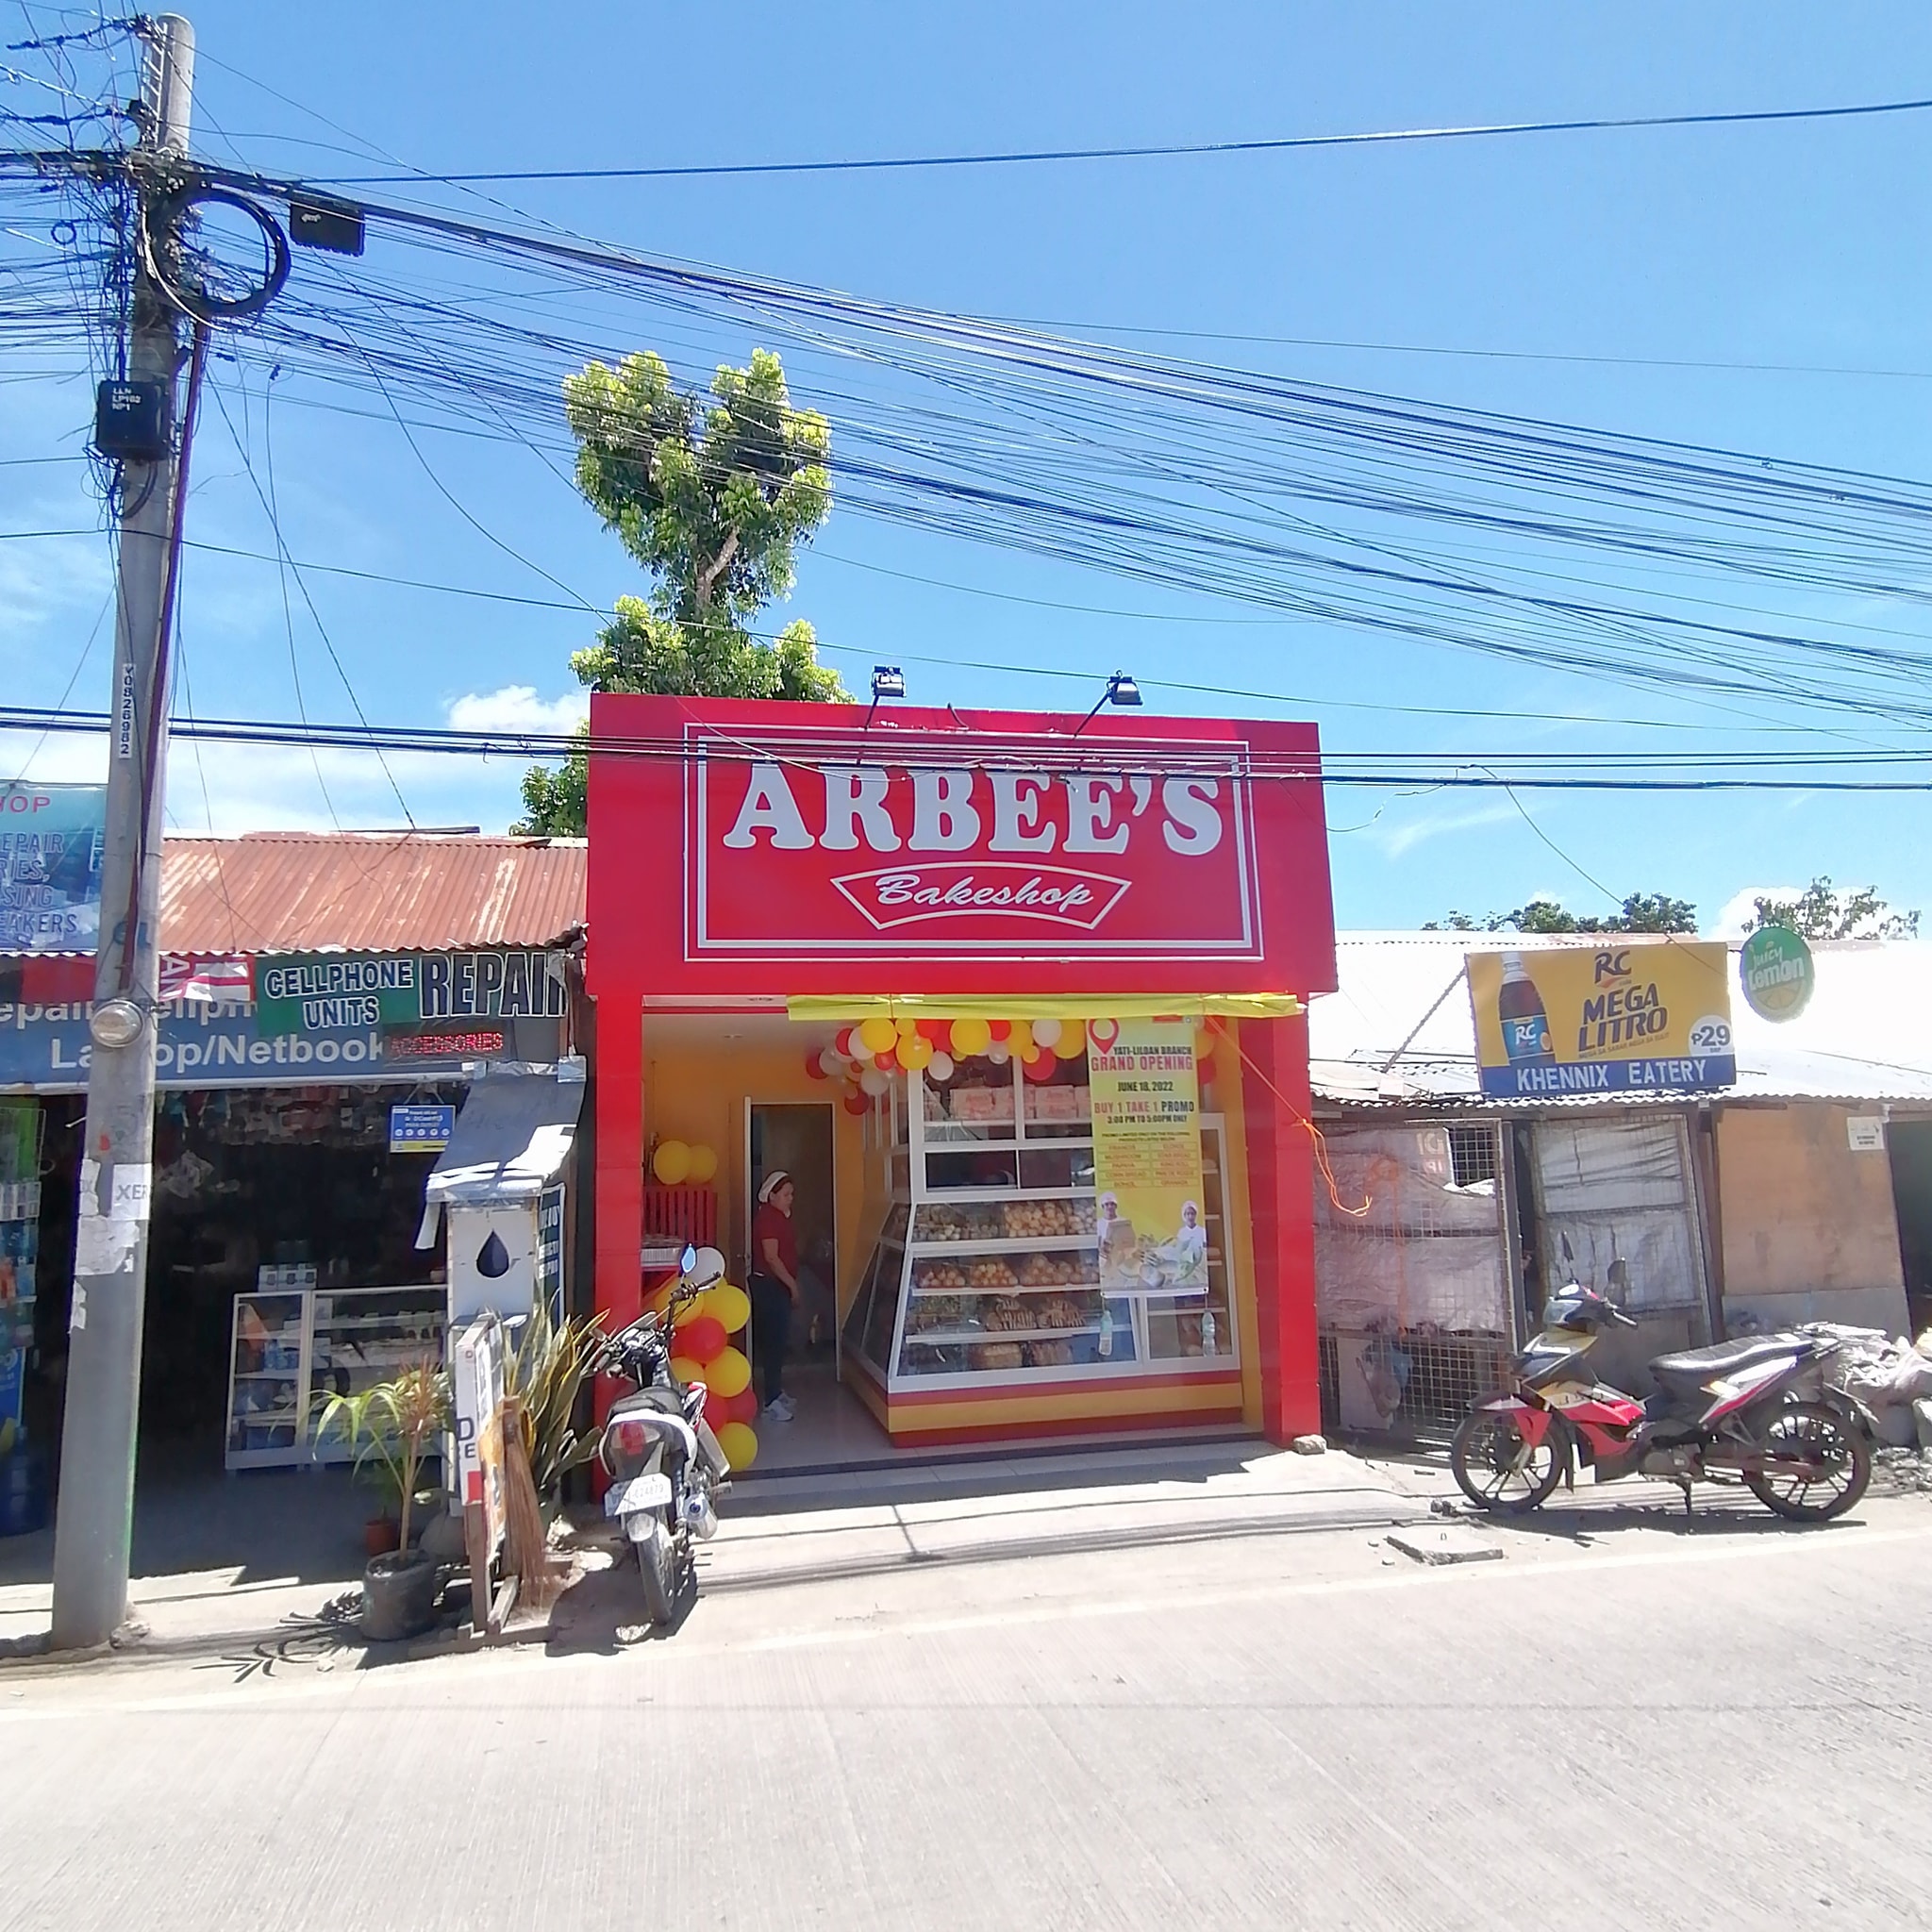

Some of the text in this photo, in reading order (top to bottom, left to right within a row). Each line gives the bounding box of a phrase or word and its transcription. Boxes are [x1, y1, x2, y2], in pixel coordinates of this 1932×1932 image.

[723, 760, 1223, 857] ARBEE'S
[874, 873, 1093, 913] Bakeshop
[264, 958, 414, 1000] CELLPHONE
[1594, 950, 1632, 984] RC
[303, 996, 380, 1030] UNITS
[1583, 982, 1659, 1025] MEGA
[1515, 1024, 1537, 1045] RC
[1578, 1007, 1668, 1052] LITRO
[1091, 1056, 1193, 1072] GRAND OPENING
[1161, 1045, 1191, 1055] BRANCH
[1118, 1081, 1138, 1091] JUNE
[1152, 1081, 1174, 1091] 2022
[1517, 1059, 1707, 1091] KHENNIX EATERY
[1094, 1102, 1113, 1113] BUY
[1126, 1101, 1150, 1112] TAKE
[1161, 1101, 1194, 1112] PROMO
[1124, 1115, 1136, 1124] PM
[1137, 1115, 1145, 1124] TO
